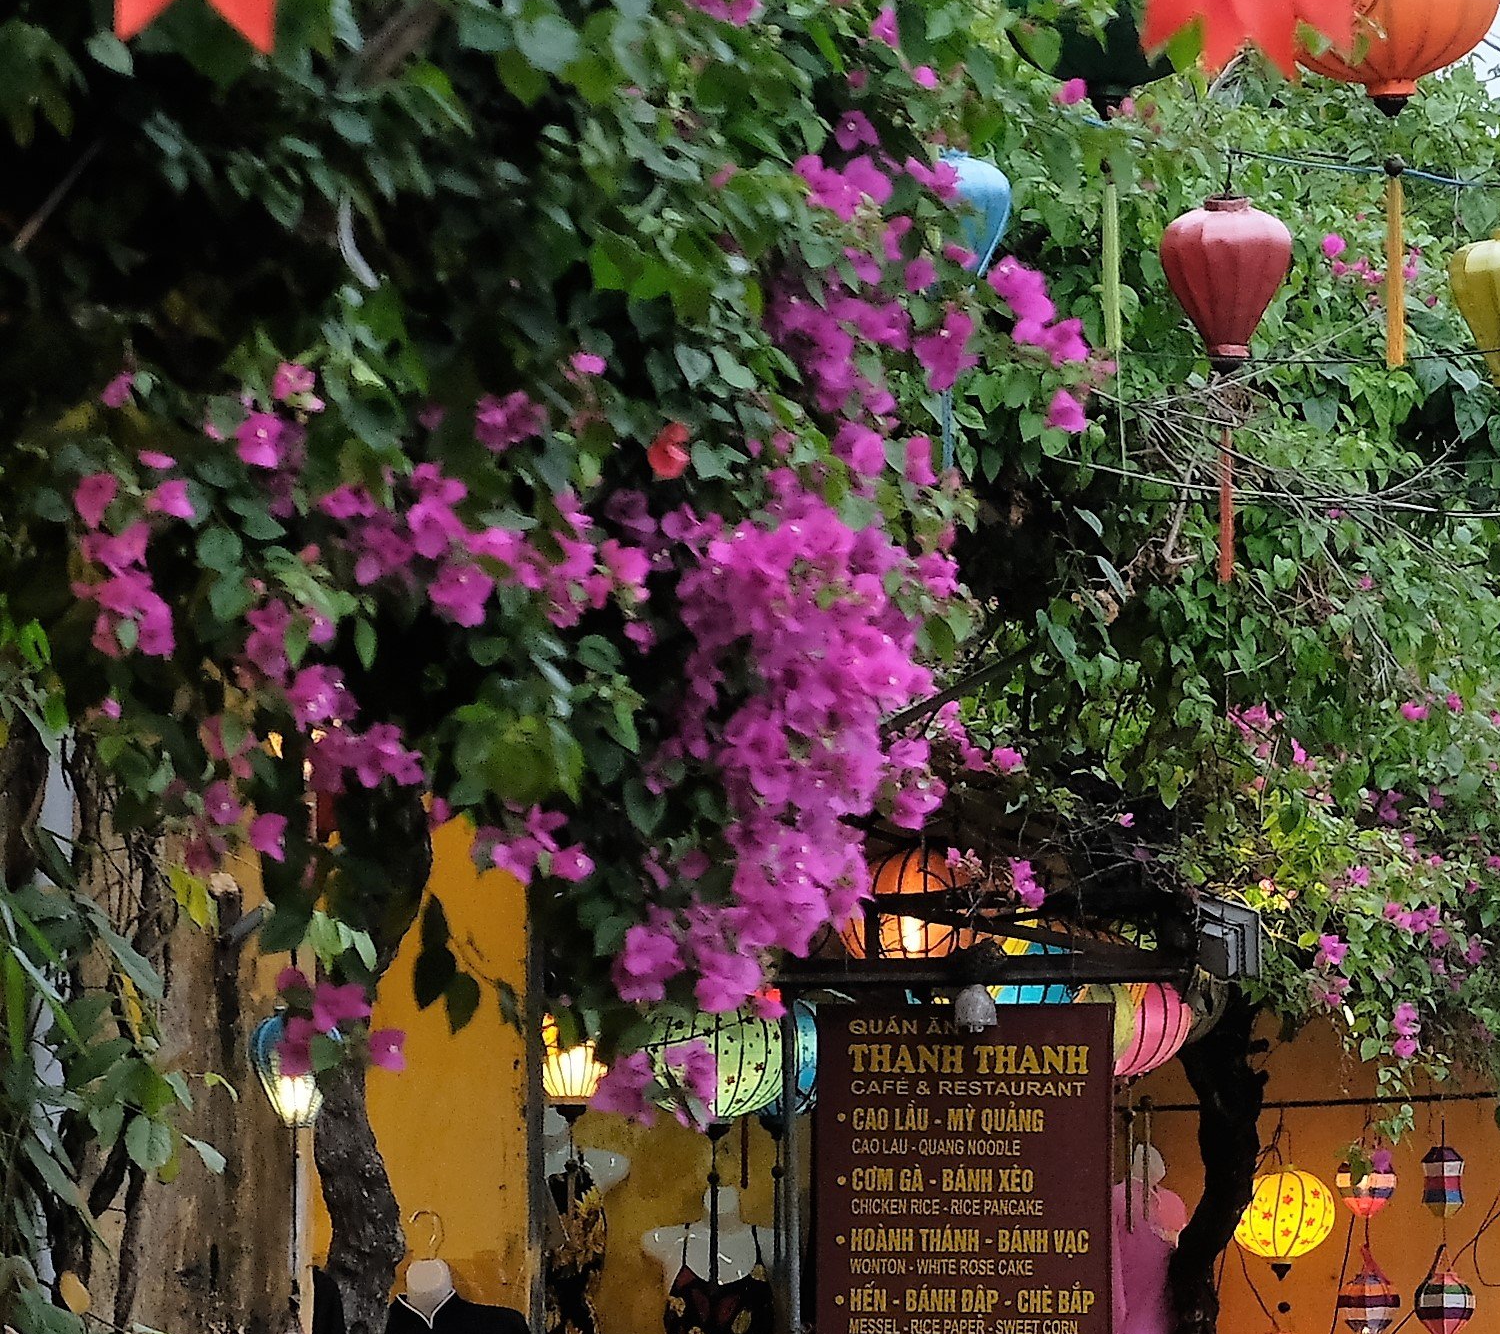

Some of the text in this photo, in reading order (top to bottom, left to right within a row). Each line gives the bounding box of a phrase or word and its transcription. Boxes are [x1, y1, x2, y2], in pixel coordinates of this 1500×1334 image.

[849, 1016, 917, 1035] QUÁN
[848, 1044, 1089, 1075] THANH THANH
[916, 1081, 931, 1095] &
[939, 1080, 1086, 1097] RESTAURANT
[853, 1108, 889, 1132] CAO
[981, 1101, 1044, 1135] QUẢNG
[852, 1139, 880, 1155] CAO
[882, 1139, 908, 1155] LAU
[918, 1139, 964, 1156] QUANG
[967, 1139, 1021, 1156] NOODLE
[852, 1165, 893, 1192] CƠM
[899, 1164, 924, 1192] GÀ
[942, 1164, 993, 1193] BÁNH
[998, 1164, 1034, 1193] XÈO
[851, 1198, 906, 1215] CHICKEN
[910, 1199, 940, 1215] RICE
[950, 1199, 980, 1215] RICE
[984, 1199, 1044, 1216] PANCAKE
[850, 1223, 914, 1252] HOÀNH
[919, 1223, 979, 1252] THÁNH
[998, 1224, 1049, 1253] BÁNH
[1054, 1229, 1090, 1259] VẠC
[850, 1258, 906, 1274] WONTON
[917, 1259, 956, 1275] WHITE
[960, 1259, 995, 1276] ROSE
[998, 1259, 1034, 1276] CAKE
[905, 1283, 956, 1313] BÁNH
[1017, 1284, 1053, 1314] CHÈ
[849, 1318, 900, 1334] MESSEL
[910, 1319, 940, 1334] RICE
